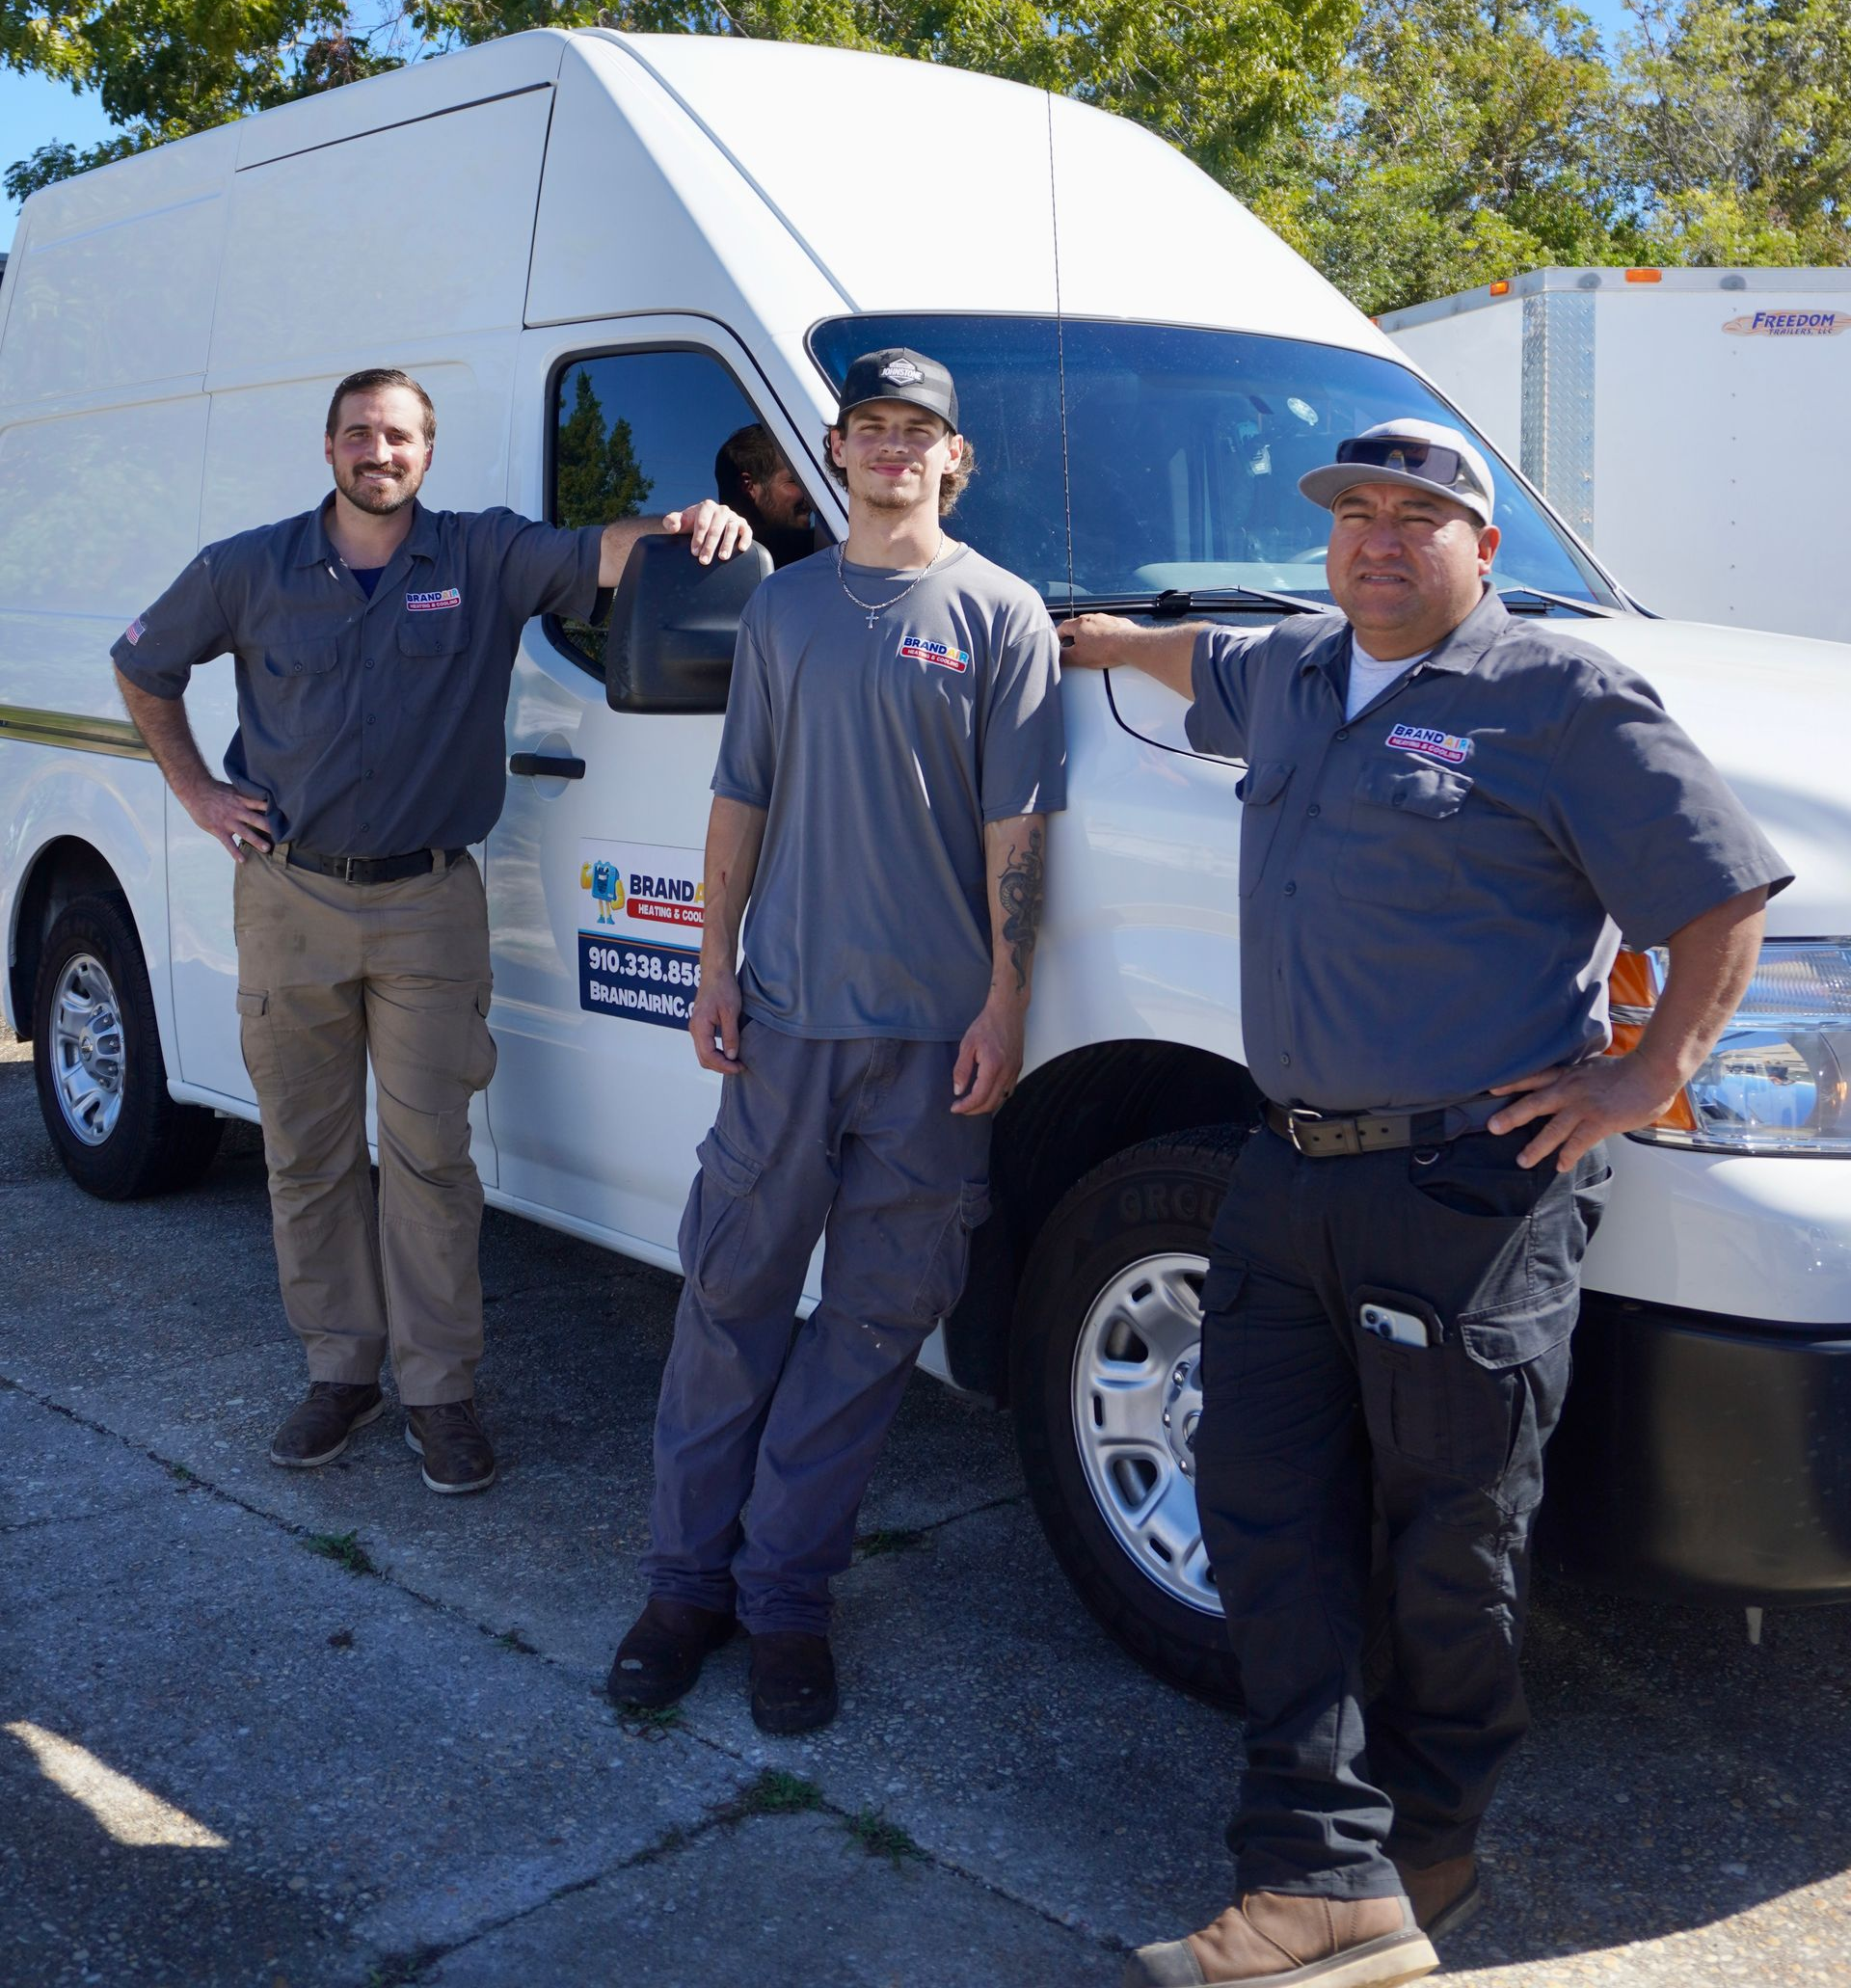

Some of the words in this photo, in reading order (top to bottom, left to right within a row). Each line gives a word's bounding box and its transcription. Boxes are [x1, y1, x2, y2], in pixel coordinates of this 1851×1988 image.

[1752, 311, 1836, 330] FREEDOM
[880, 367, 923, 381] JOHNSTONE
[436, 599, 458, 607] COOLING
[907, 649, 930, 659] HEATING
[936, 657, 959, 668] COOLING
[1391, 739, 1421, 748] HEATING
[1428, 744, 1462, 760] COOLING
[630, 873, 705, 903] BRANDA
[638, 903, 672, 919] HEATING
[673, 908, 681, 920] &
[682, 909, 705, 923] COOL
